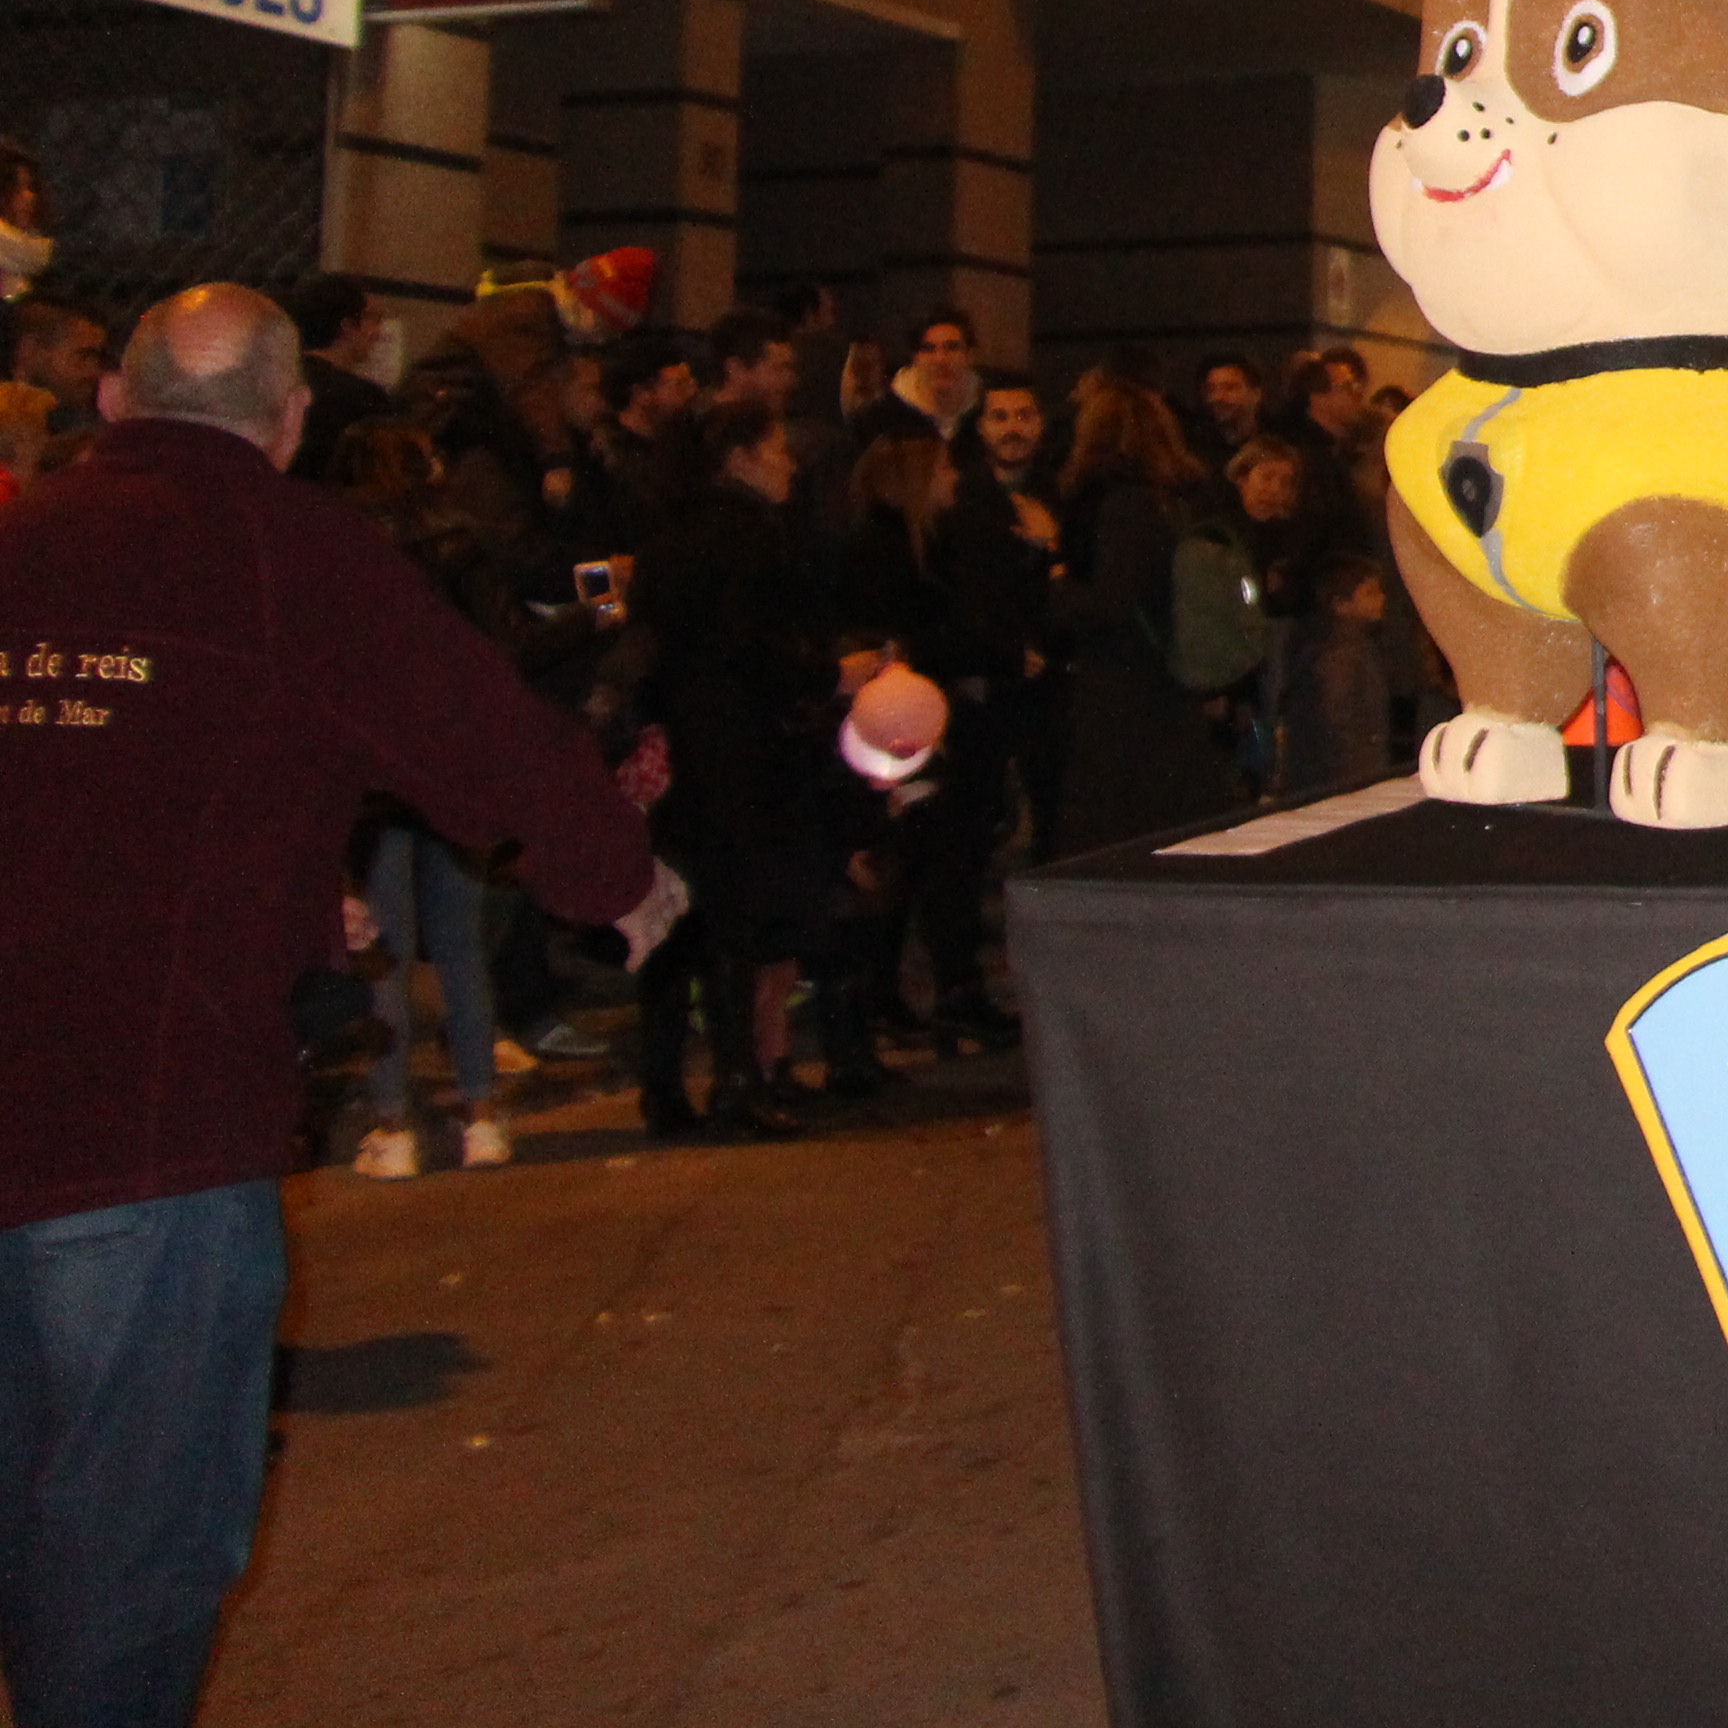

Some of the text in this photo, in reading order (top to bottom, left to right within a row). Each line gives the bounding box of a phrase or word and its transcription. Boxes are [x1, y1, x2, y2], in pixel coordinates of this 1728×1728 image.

[25, 642, 63, 678] de
[74, 646, 150, 683] reis
[18, 699, 46, 725] de
[55, 698, 111, 726] Mar
